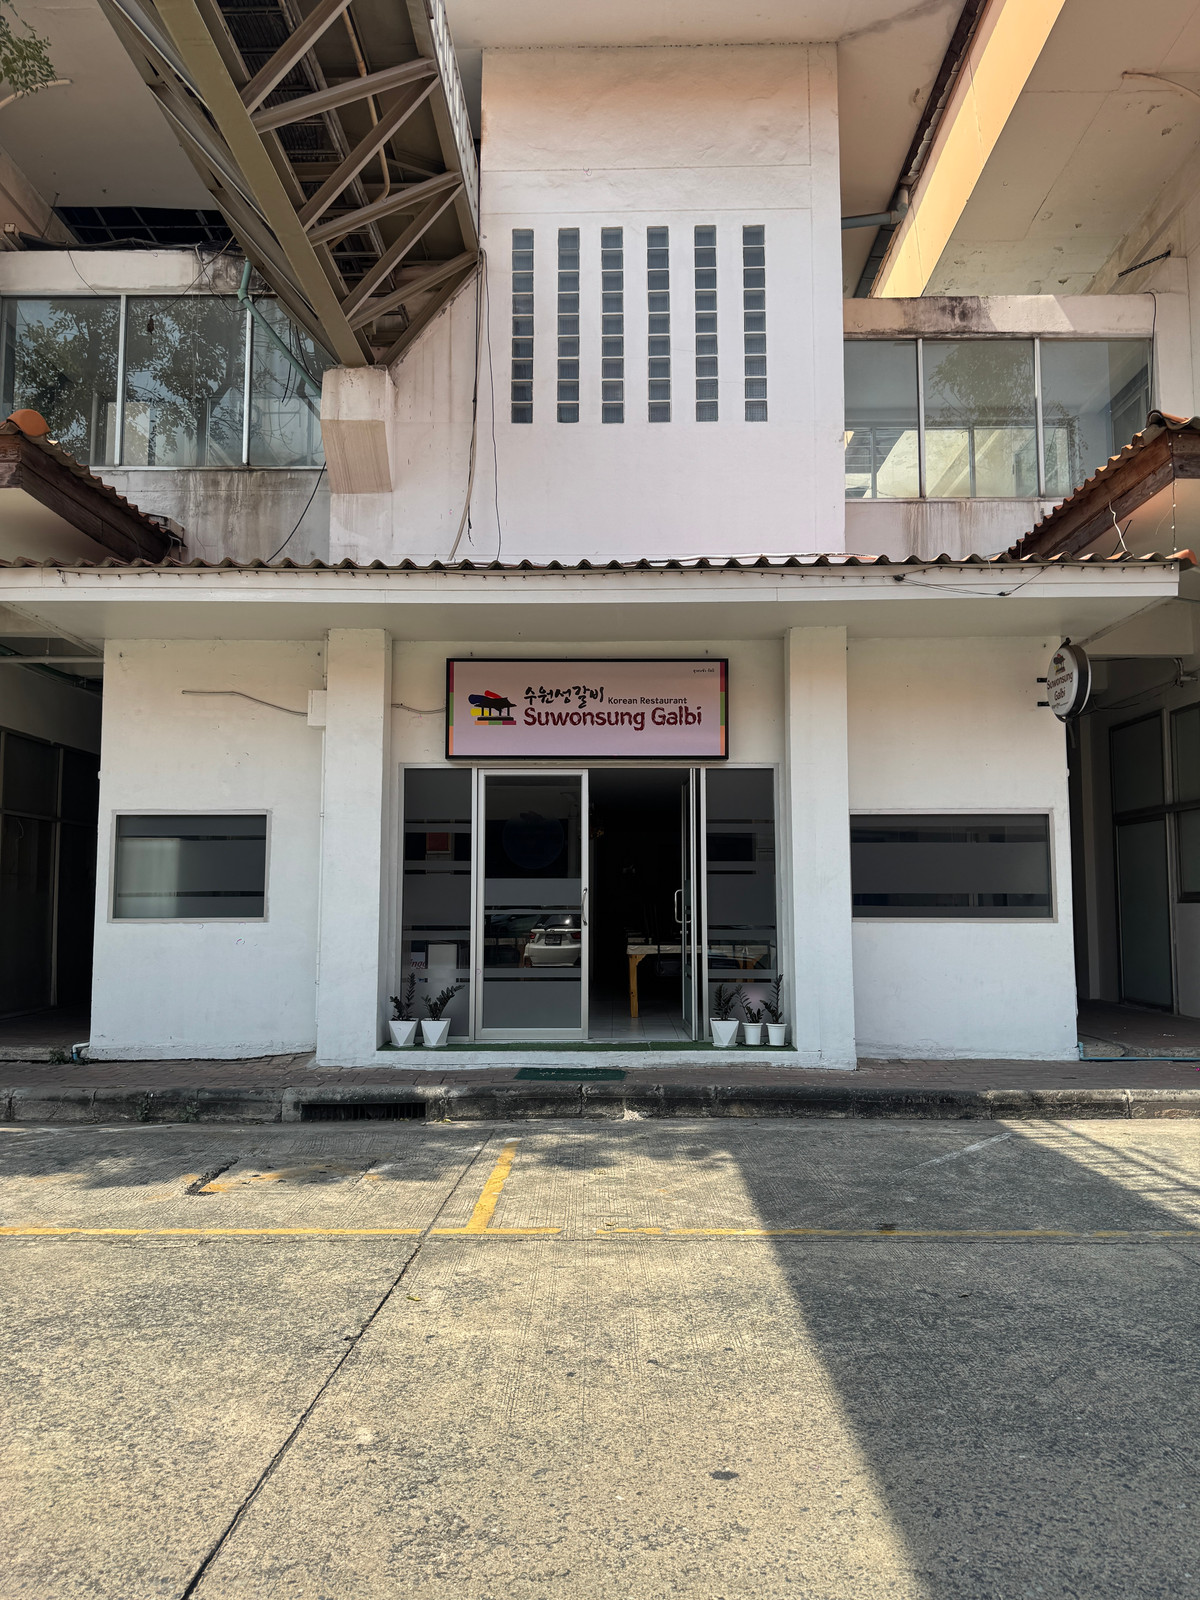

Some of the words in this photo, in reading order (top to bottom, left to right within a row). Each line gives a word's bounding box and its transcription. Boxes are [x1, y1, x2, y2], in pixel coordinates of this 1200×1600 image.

[524, 685, 604, 708] 수원성갈비
[608, 696, 638, 705] Korean
[640, 696, 688, 705] Restaurant
[1054, 687, 1065, 701] Galbi
[523, 707, 646, 732] Suwonsung
[651, 705, 702, 726] Galbi
